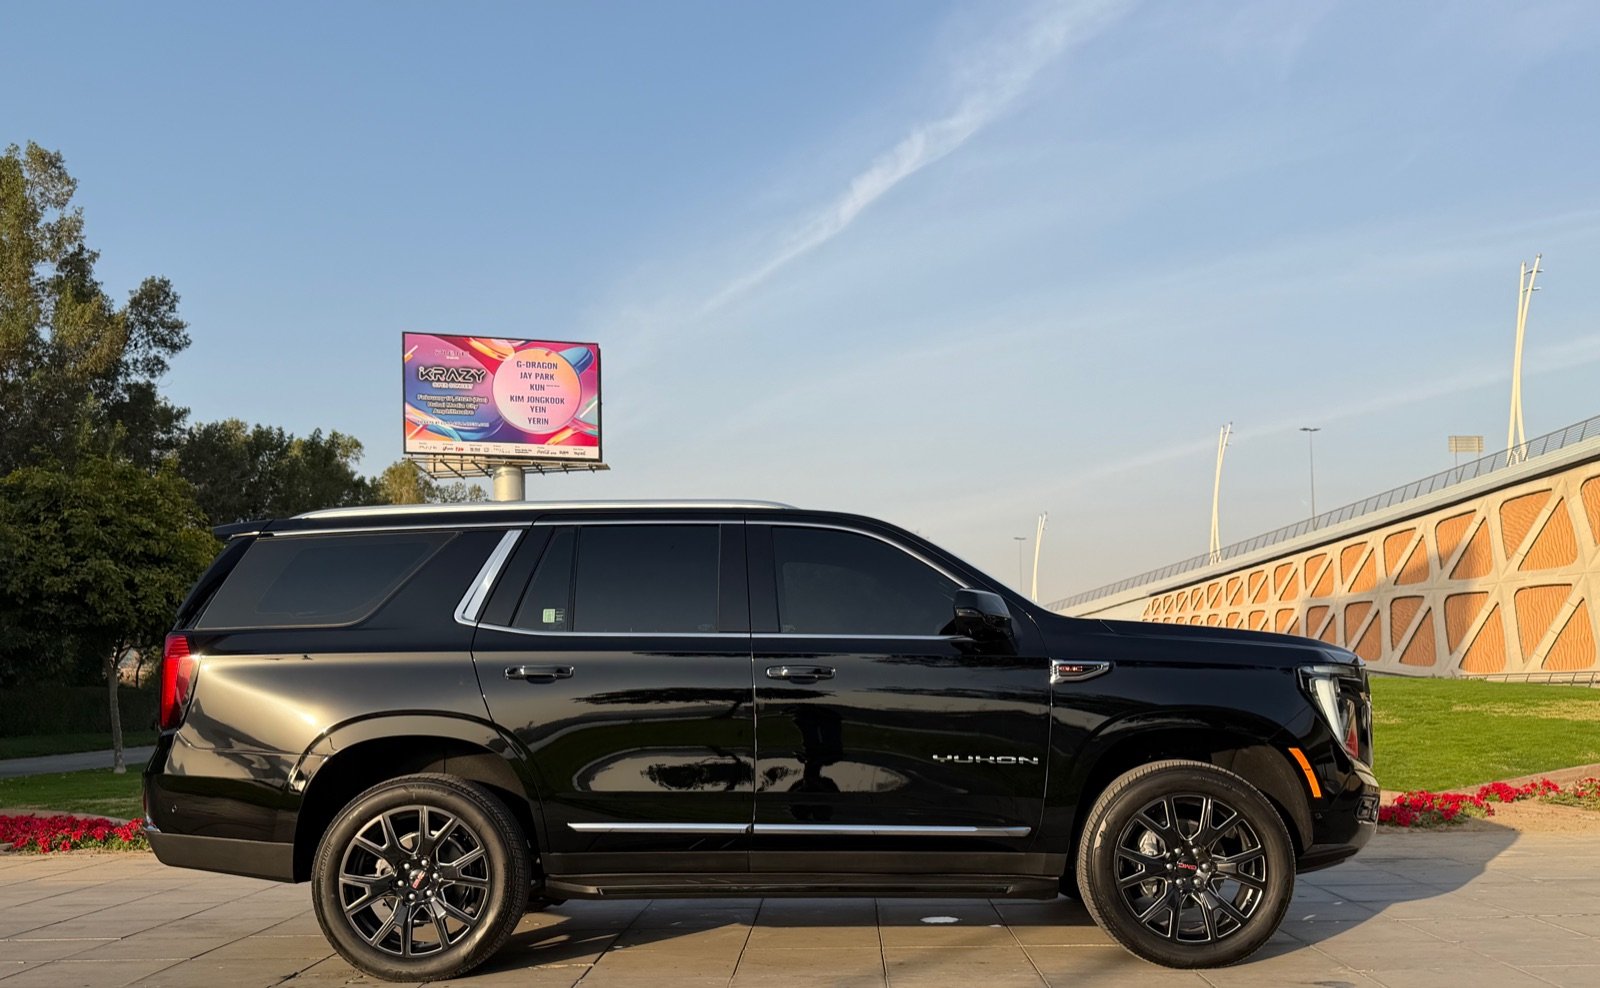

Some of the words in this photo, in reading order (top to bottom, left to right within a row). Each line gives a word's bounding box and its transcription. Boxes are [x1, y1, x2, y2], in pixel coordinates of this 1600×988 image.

[516, 361, 558, 370] G-DRAGON
[520, 372, 533, 380] JAY
[535, 373, 555, 381] PARK
[527, 396, 565, 405] JONGKOOK
[527, 417, 549, 425] YERIN
[932, 754, 1039, 765] YUKON
[1178, 863, 1197, 871] GMC
